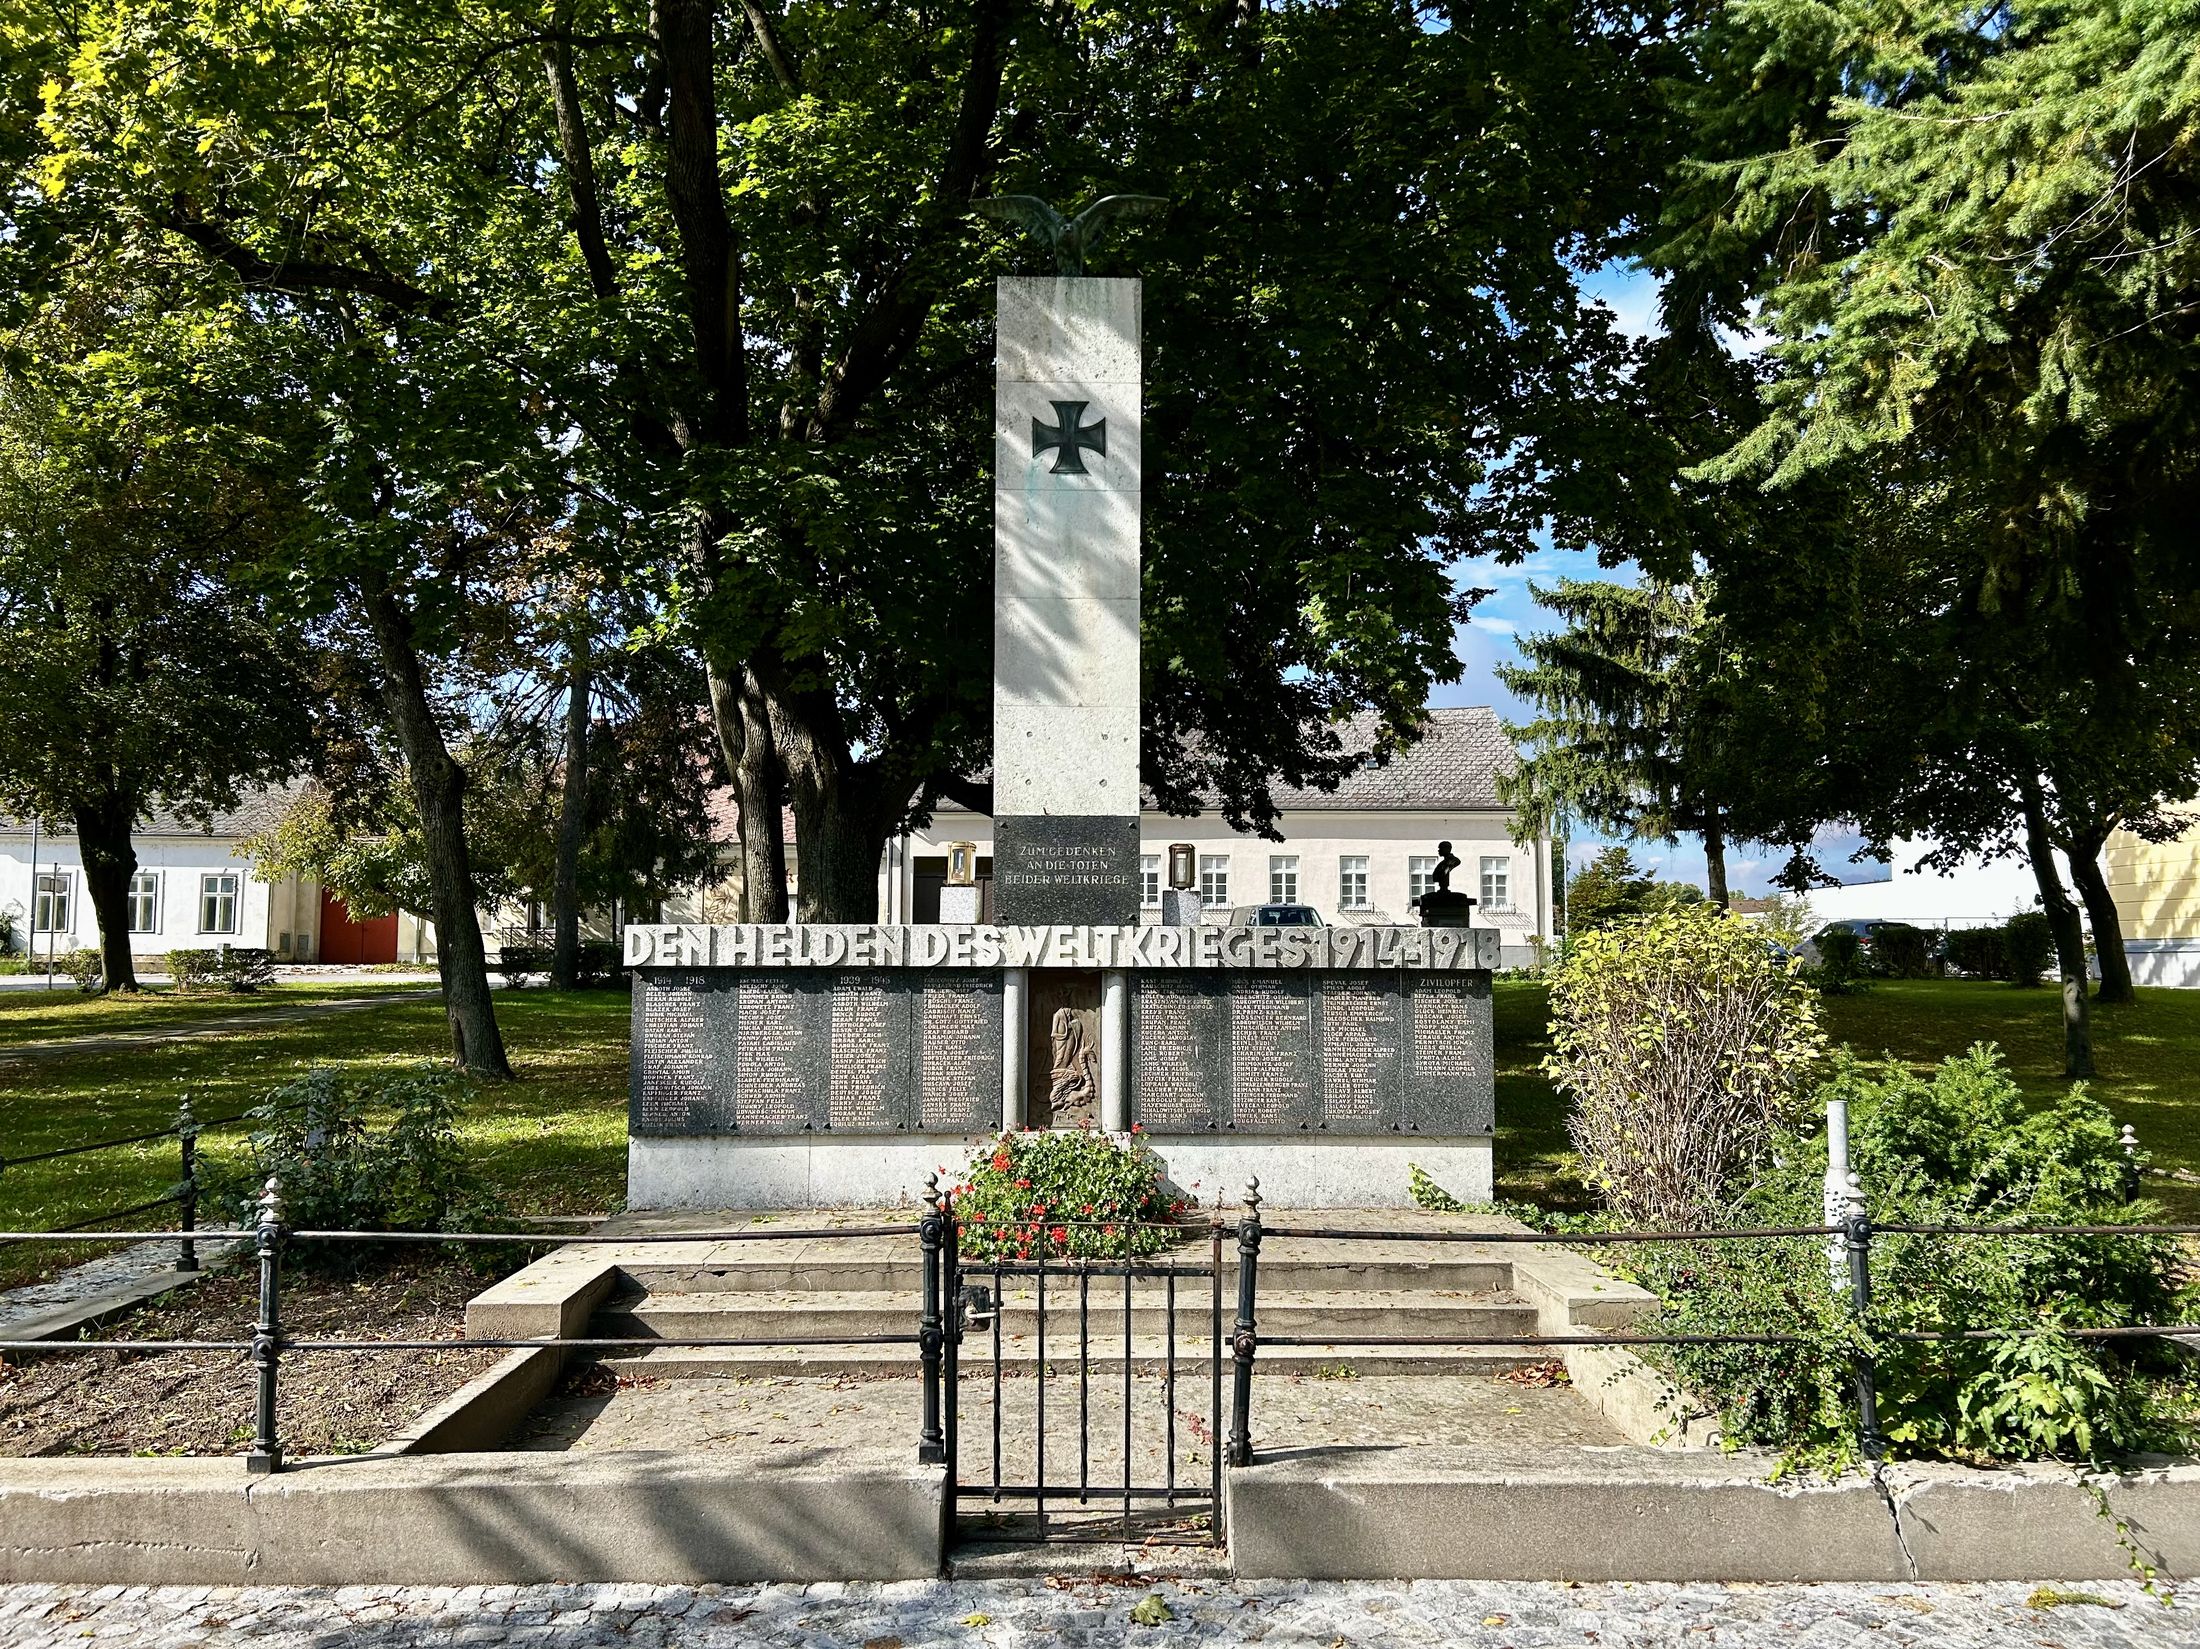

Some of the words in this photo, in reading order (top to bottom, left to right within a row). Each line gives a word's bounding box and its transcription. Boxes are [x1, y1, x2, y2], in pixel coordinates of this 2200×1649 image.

[1020, 847, 1045, 856] ZUM
[1049, 847, 1116, 856] GEDENKEN
[1027, 861, 1042, 870] AN
[1046, 861, 1065, 870] DIE
[1070, 861, 1108, 870] TOTEN
[1005, 875, 1050, 884] BEIDER
[1054, 875, 1129, 884] WELTKRIEGE
[623, 925, 711, 967] DEN
[719, 924, 904, 967] HELDEN
[914, 924, 1002, 967] DES
[1006, 925, 1308, 968] WELTKRIEGES
[1313, 927, 1501, 969] 1914-1918
[654, 976, 671, 985] 1914
[685, 976, 705, 985] 1918
[840, 975, 861, 984] 1939
[1420, 978, 1473, 987] ZIVILOPFER
